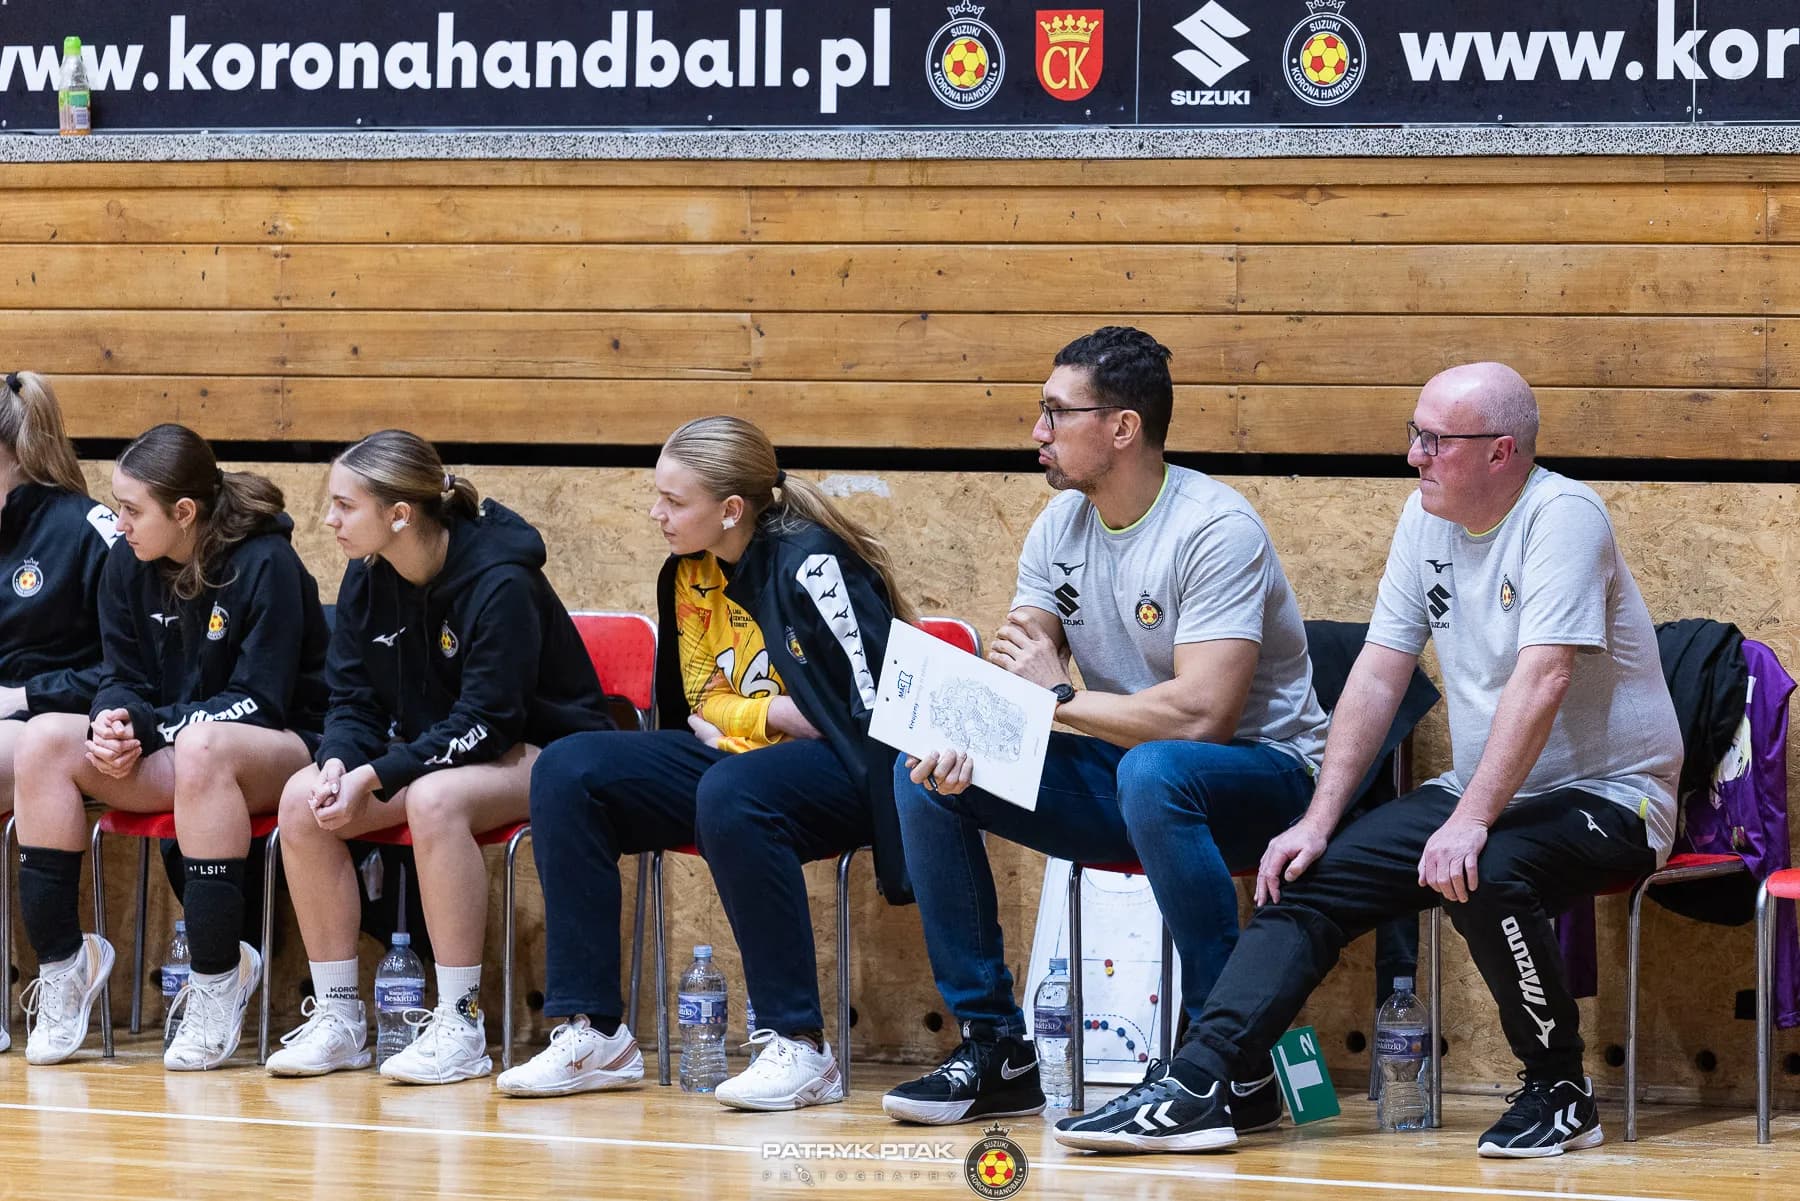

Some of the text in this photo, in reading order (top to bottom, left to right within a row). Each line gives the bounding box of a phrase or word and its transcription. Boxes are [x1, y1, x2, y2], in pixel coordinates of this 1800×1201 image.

[951, 25, 981, 37] SUZUKI
[1309, 20, 1341, 32] SUZUKI
[0, 8, 890, 114] ww.koronahandball.pl
[1042, 45, 1091, 90] CK
[933, 71, 998, 103] KORONA HANDBALL
[1170, 90, 1250, 106] SUZUKI
[1291, 66, 1359, 99] KORONA HANDBALL
[715, 646, 781, 699] 16
[449, 724, 488, 753] MIZU
[1501, 915, 1547, 1006] MIZUNO
